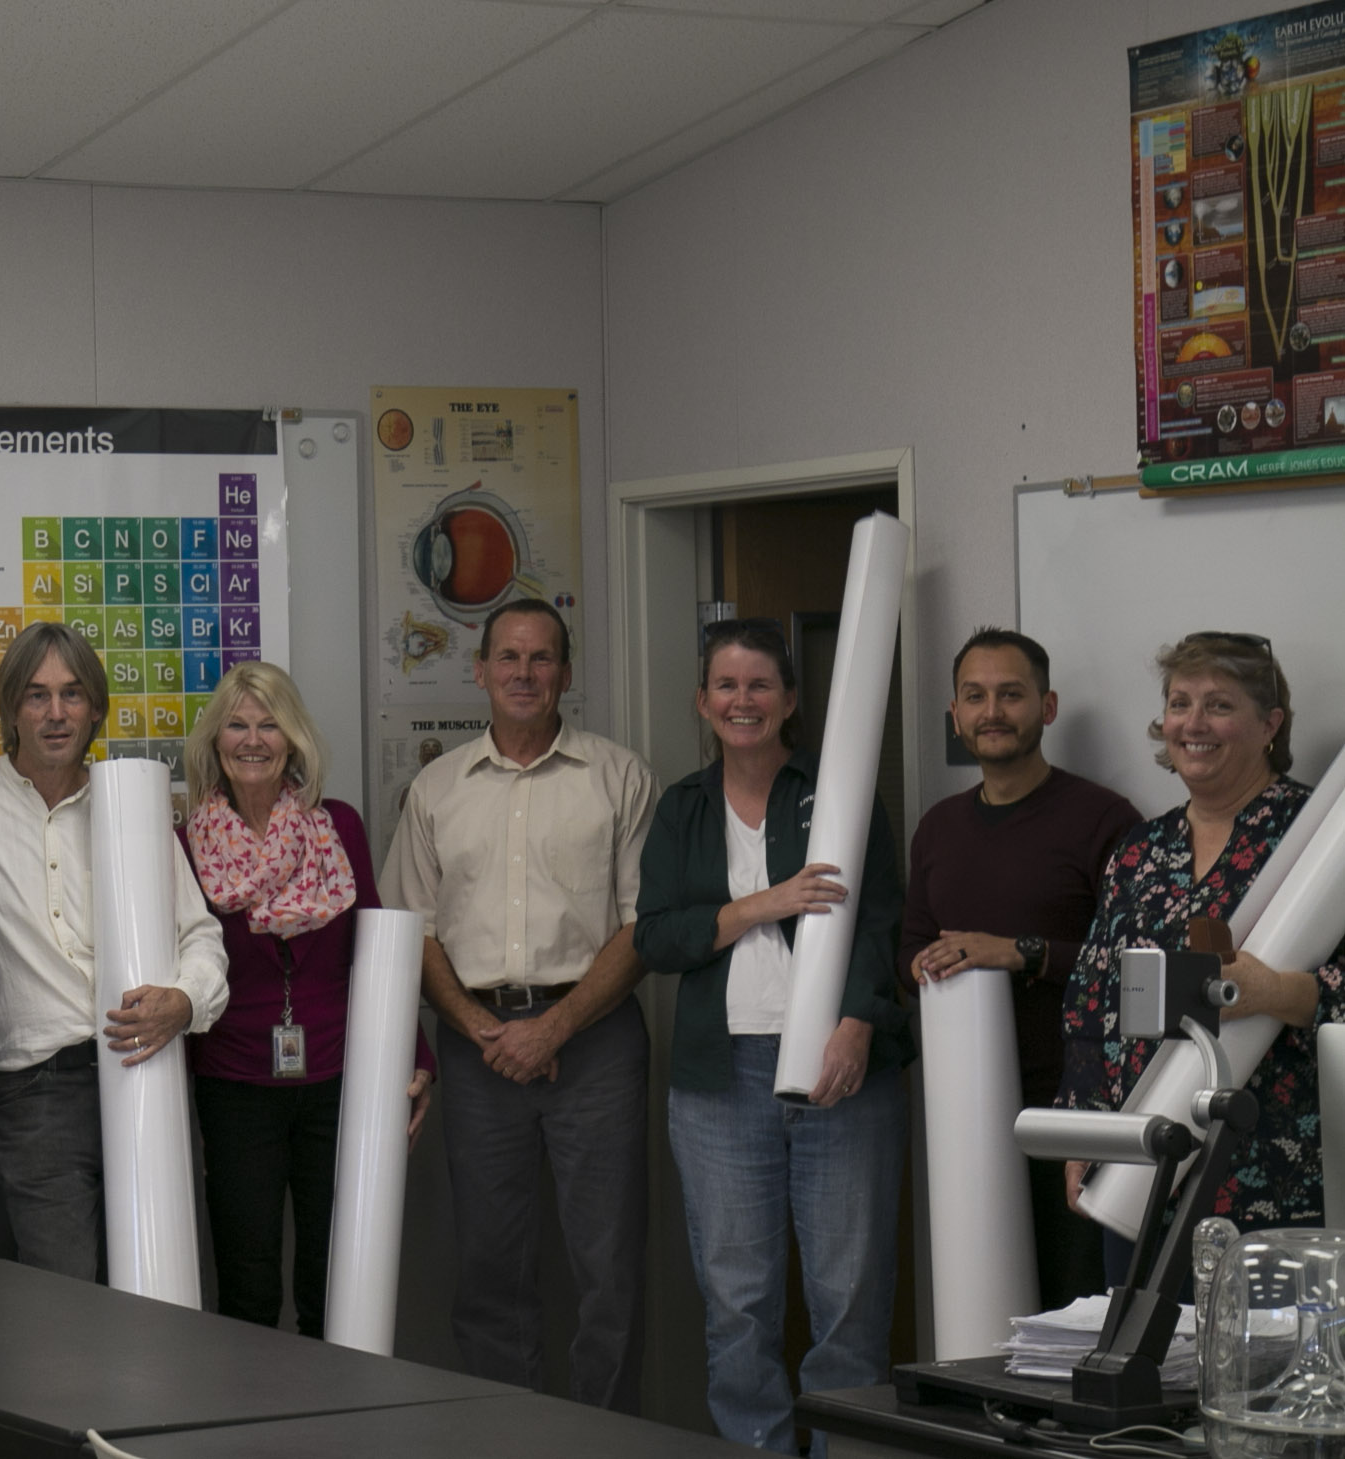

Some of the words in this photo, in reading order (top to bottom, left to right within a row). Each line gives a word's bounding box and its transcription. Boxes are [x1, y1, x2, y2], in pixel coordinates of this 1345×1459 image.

[1275, 20, 1307, 39] EARTH
[1310, 11, 1345, 31] EVOLU
[448, 402, 474, 413] THE
[476, 402, 500, 413] EYE
[1170, 459, 1249, 482] CRAM
[1289, 458, 1319, 473] JONES
[225, 486, 252, 504] He
[34, 530, 50, 548] B
[74, 529, 90, 549] C
[115, 530, 129, 548] N
[152, 529, 168, 549] O
[194, 530, 206, 548] F
[226, 530, 252, 549] Ne
[32, 574, 52, 594] Al
[74, 574, 93, 594] Si
[116, 574, 130, 593] P
[154, 574, 167, 593] S
[190, 574, 210, 593] Cl
[228, 574, 252, 592] Ar
[112, 618, 138, 638] As
[150, 618, 176, 638] Se
[192, 618, 214, 637] Br
[230, 618, 252, 637] Kr
[114, 663, 140, 683] Sb
[152, 662, 176, 682] Te
[200, 662, 205, 681] I
[118, 708, 137, 727] Bi
[154, 707, 178, 726] Po
[411, 720, 436, 731] THE
